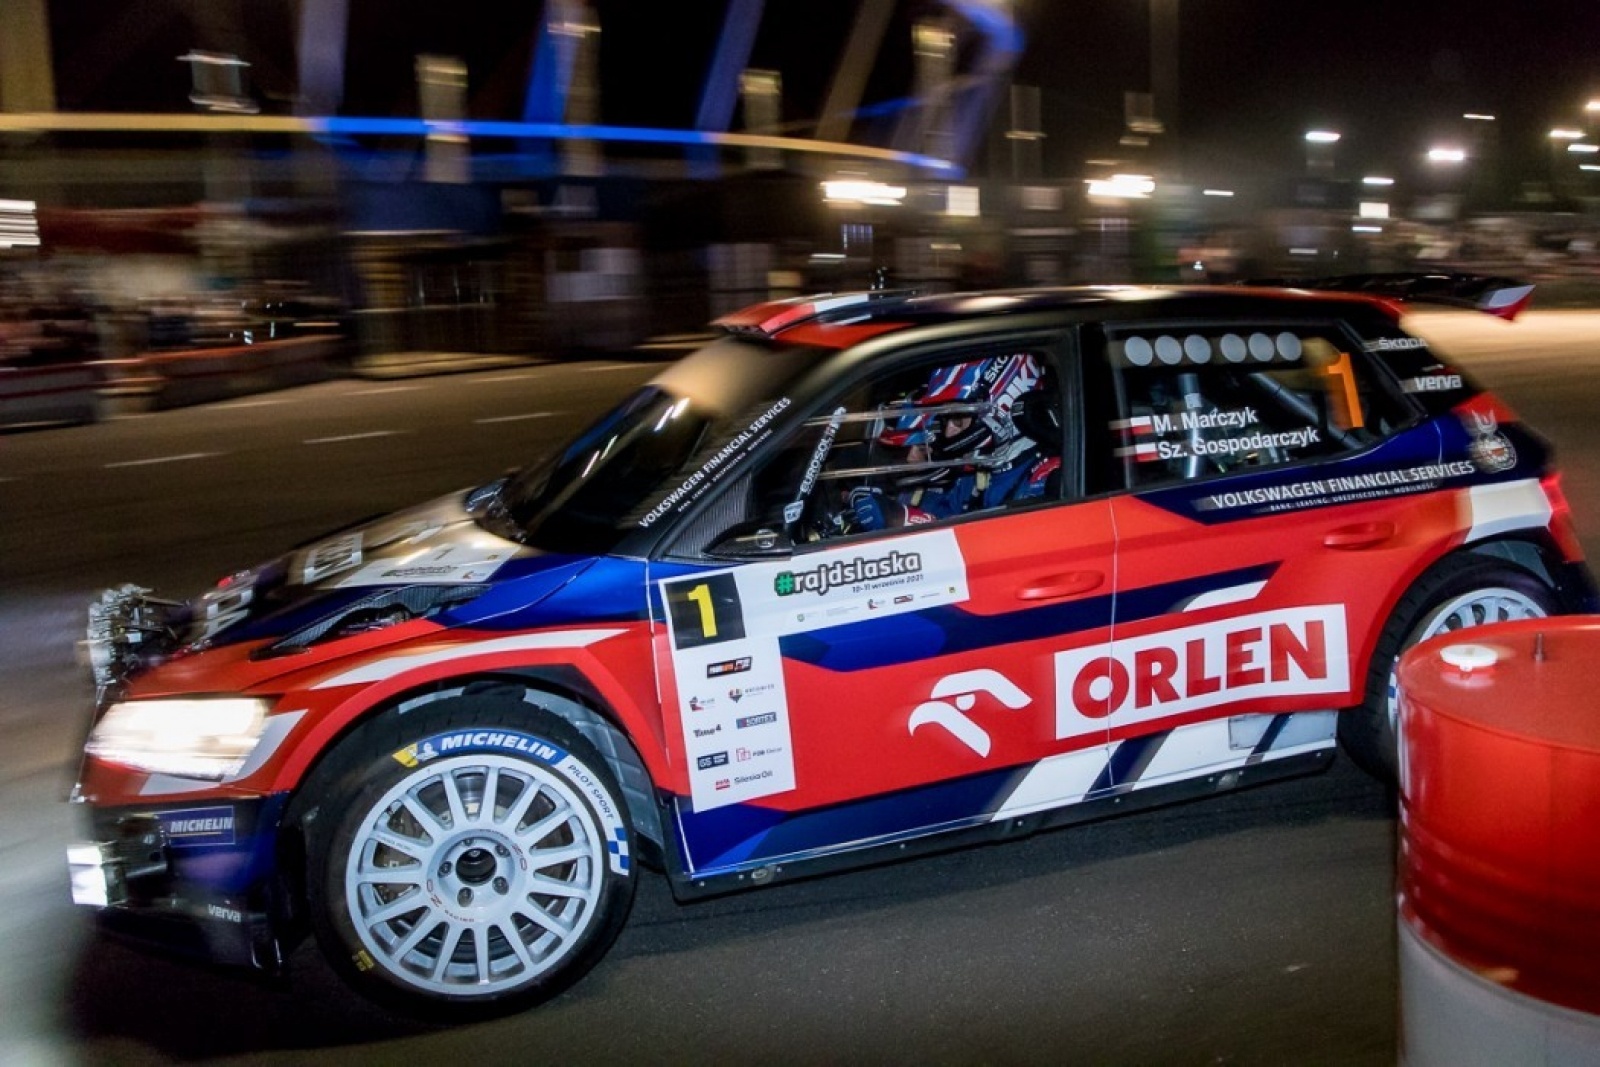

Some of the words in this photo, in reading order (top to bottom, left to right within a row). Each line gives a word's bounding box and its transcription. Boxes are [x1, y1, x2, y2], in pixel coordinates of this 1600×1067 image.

[1328, 352, 1364, 428] 1
[1414, 375, 1462, 391] verva
[1153, 414, 1177, 432] M.
[1157, 441, 1187, 459] Sz.
[1193, 426, 1320, 456] Gospodarczyk
[638, 470, 705, 528] VOLKSWAGEN
[703, 430, 753, 473] FINANCIAL
[749, 397, 791, 434] SERVICES
[1211, 481, 1326, 509] VOLKSWAGEN
[1327, 469, 1410, 494] FINANCIAL
[1410, 460, 1475, 481] SERVICES
[774, 550, 922, 596] #rajdslaska
[687, 584, 718, 638] 1
[1072, 620, 1327, 718] ORLEN
[441, 732, 556, 760] MICHELIN
[567, 764, 593, 788] PILOT
[591, 789, 614, 819] SPORT
[171, 817, 234, 833] MICHELIN
[208, 904, 242, 922] verva
